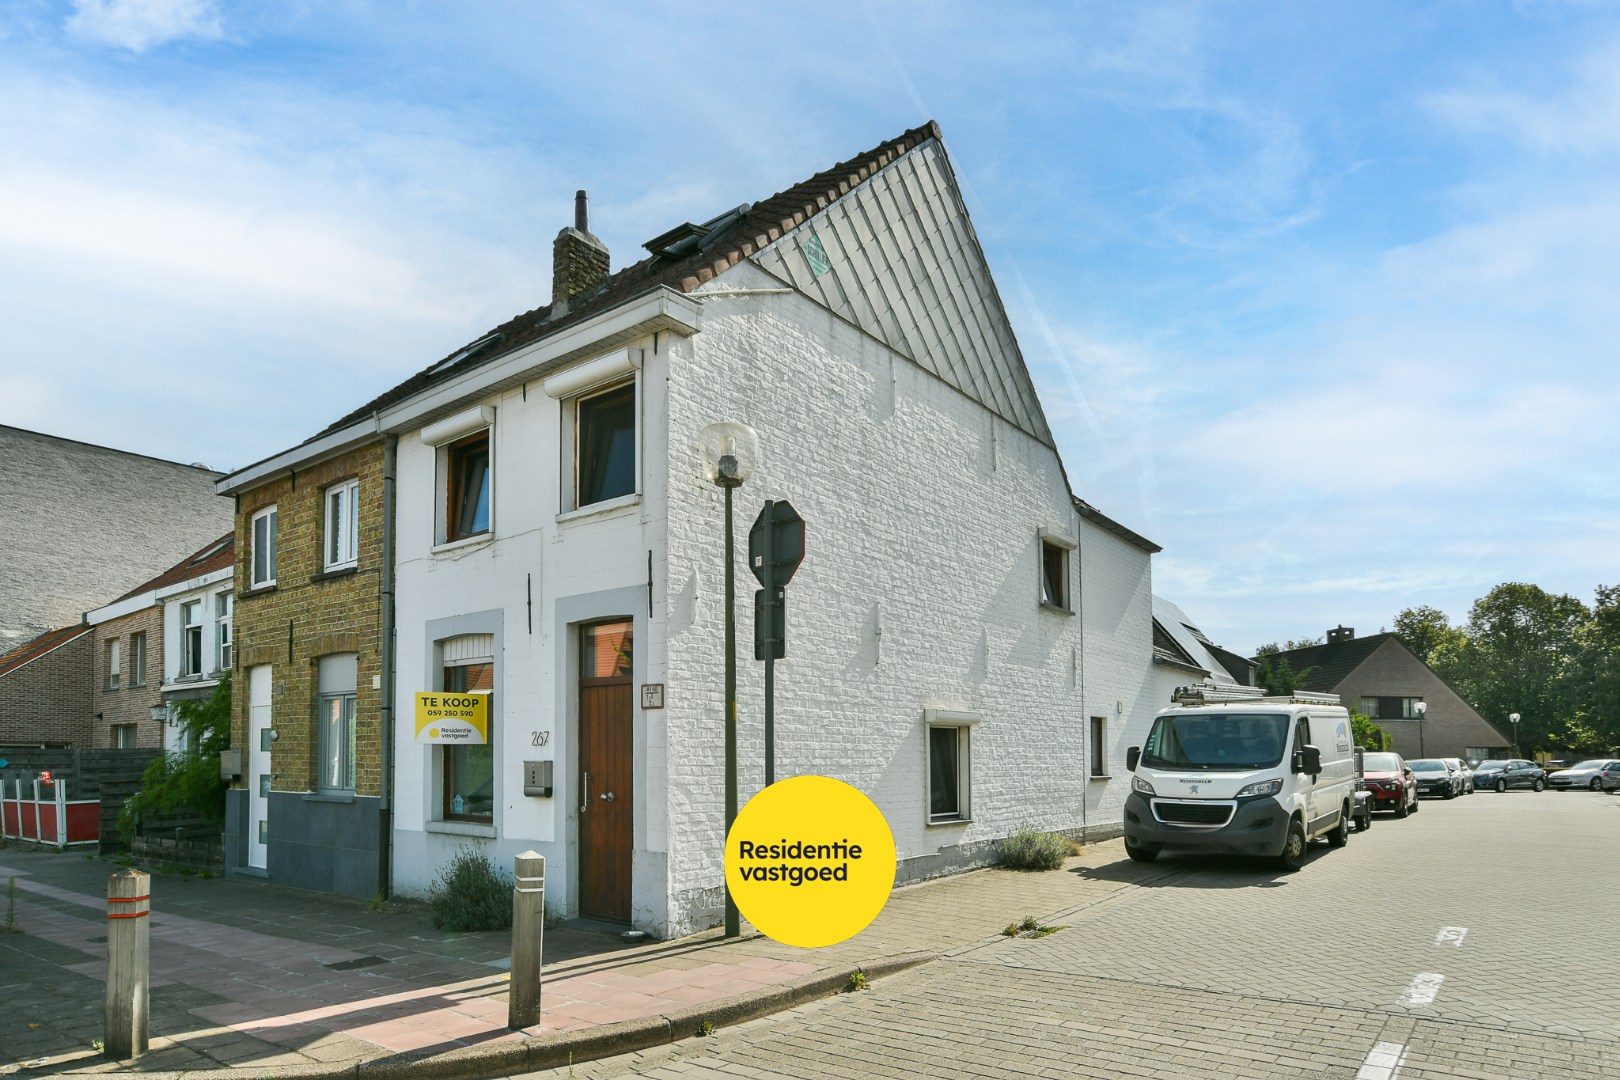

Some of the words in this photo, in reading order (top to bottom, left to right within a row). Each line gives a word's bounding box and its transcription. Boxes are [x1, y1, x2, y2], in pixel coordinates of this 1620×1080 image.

[421, 697, 438, 707] TE
[443, 697, 479, 708] KOOP
[531, 731, 550, 747] 267
